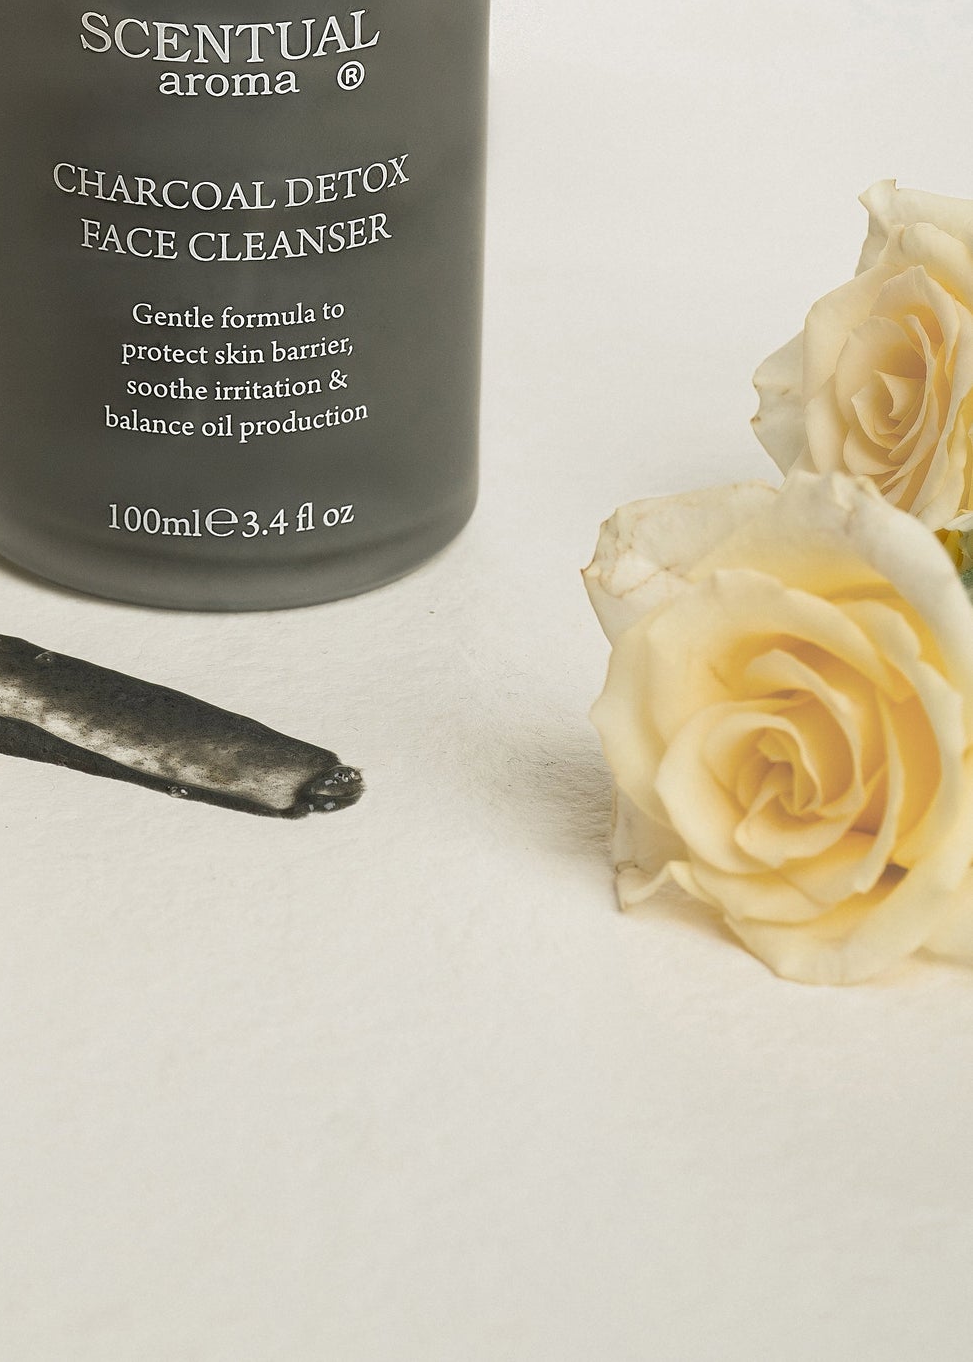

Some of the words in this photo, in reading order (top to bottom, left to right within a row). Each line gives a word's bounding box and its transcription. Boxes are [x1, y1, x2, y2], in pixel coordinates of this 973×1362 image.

[81, 10, 380, 62] SCENTUAL
[159, 71, 300, 96] aroma
[54, 163, 276, 210] CHARCOAL
[285, 154, 409, 207] DETOX
[81, 219, 177, 259] FACE
[189, 213, 392, 261] CLEANSER
[133, 303, 214, 328] Gentle
[221, 302, 316, 328] formula
[323, 303, 344, 319] to
[122, 343, 208, 365] protect
[215, 342, 265, 364] skin
[271, 337, 352, 362] barrier,
[127, 378, 207, 400] soothe
[215, 378, 322, 400] irritation
[329, 370, 347, 389] &
[105, 405, 194, 435] balance
[202, 415, 233, 436] oil
[239, 405, 368, 443] production
[296, 502, 315, 531] fl
[323, 505, 354, 527] oz
